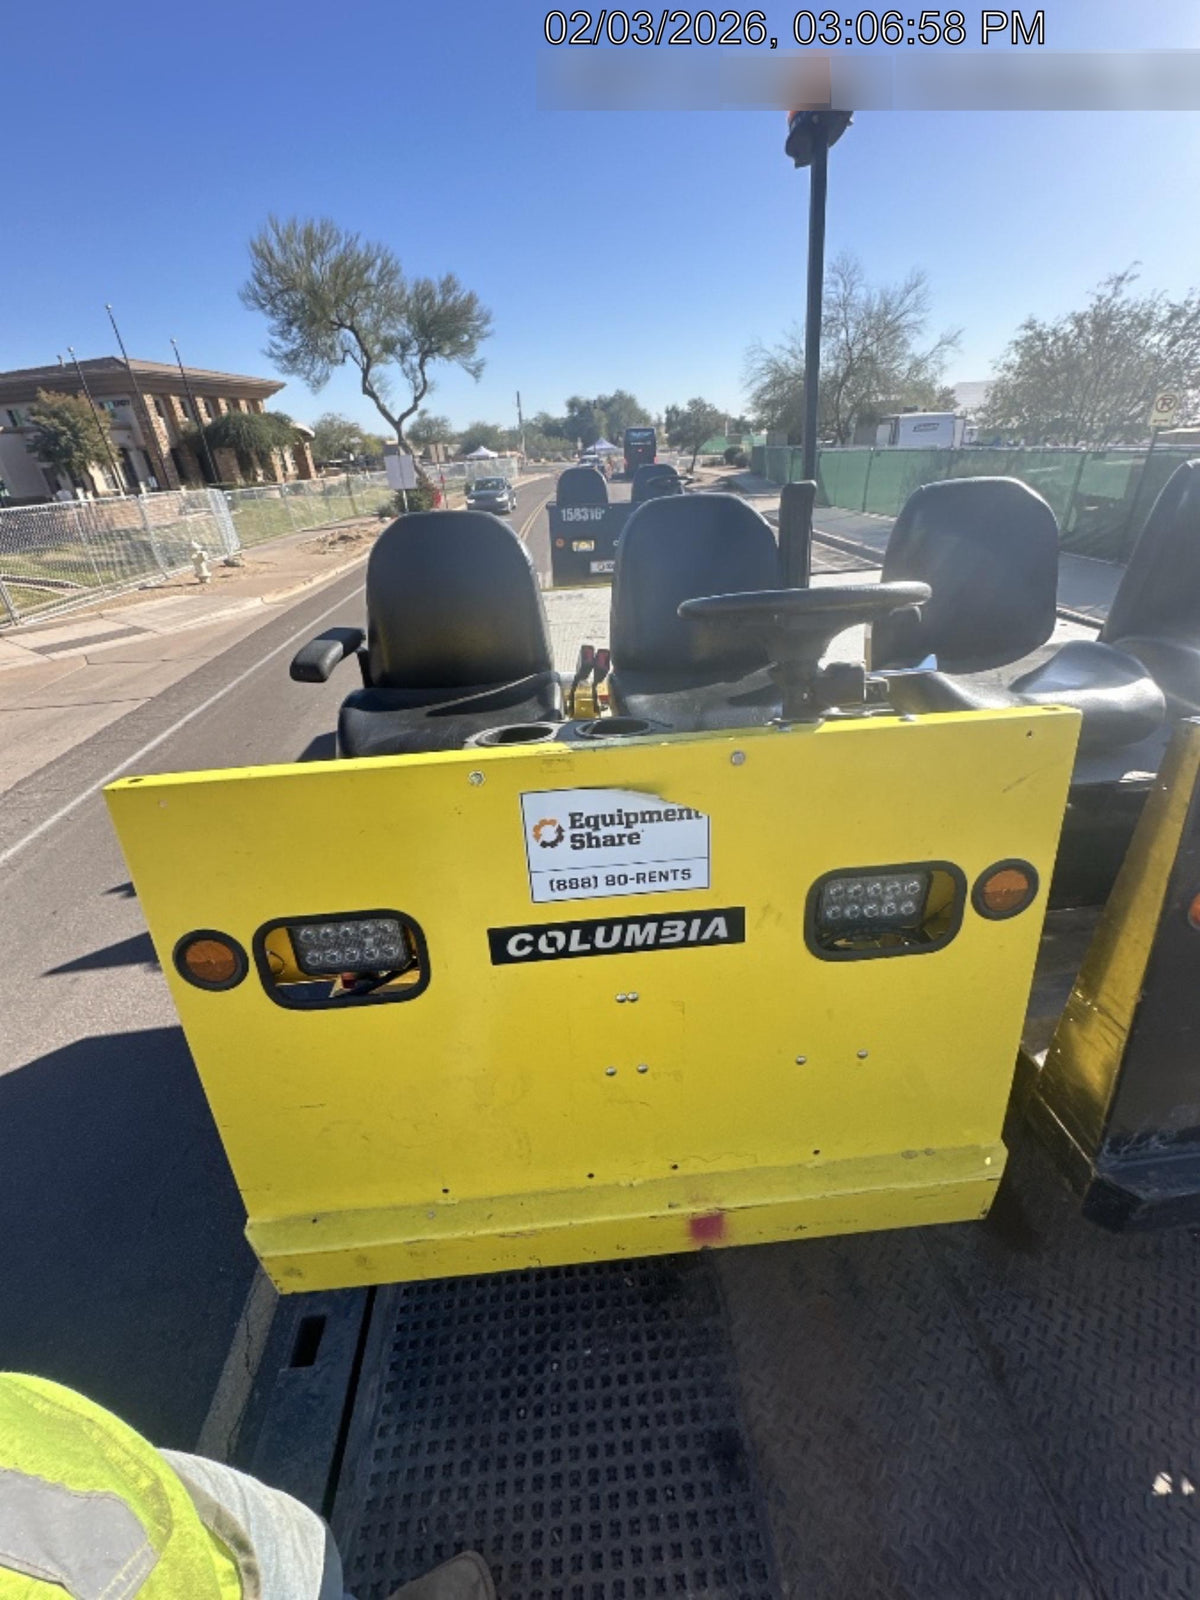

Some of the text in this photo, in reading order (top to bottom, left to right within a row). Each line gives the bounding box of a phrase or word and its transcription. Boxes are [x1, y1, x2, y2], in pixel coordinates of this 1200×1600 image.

[570, 831, 641, 850] Share
[549, 868, 692, 892] (888) 80-RENTS
[506, 916, 729, 957] COLUMBIA
